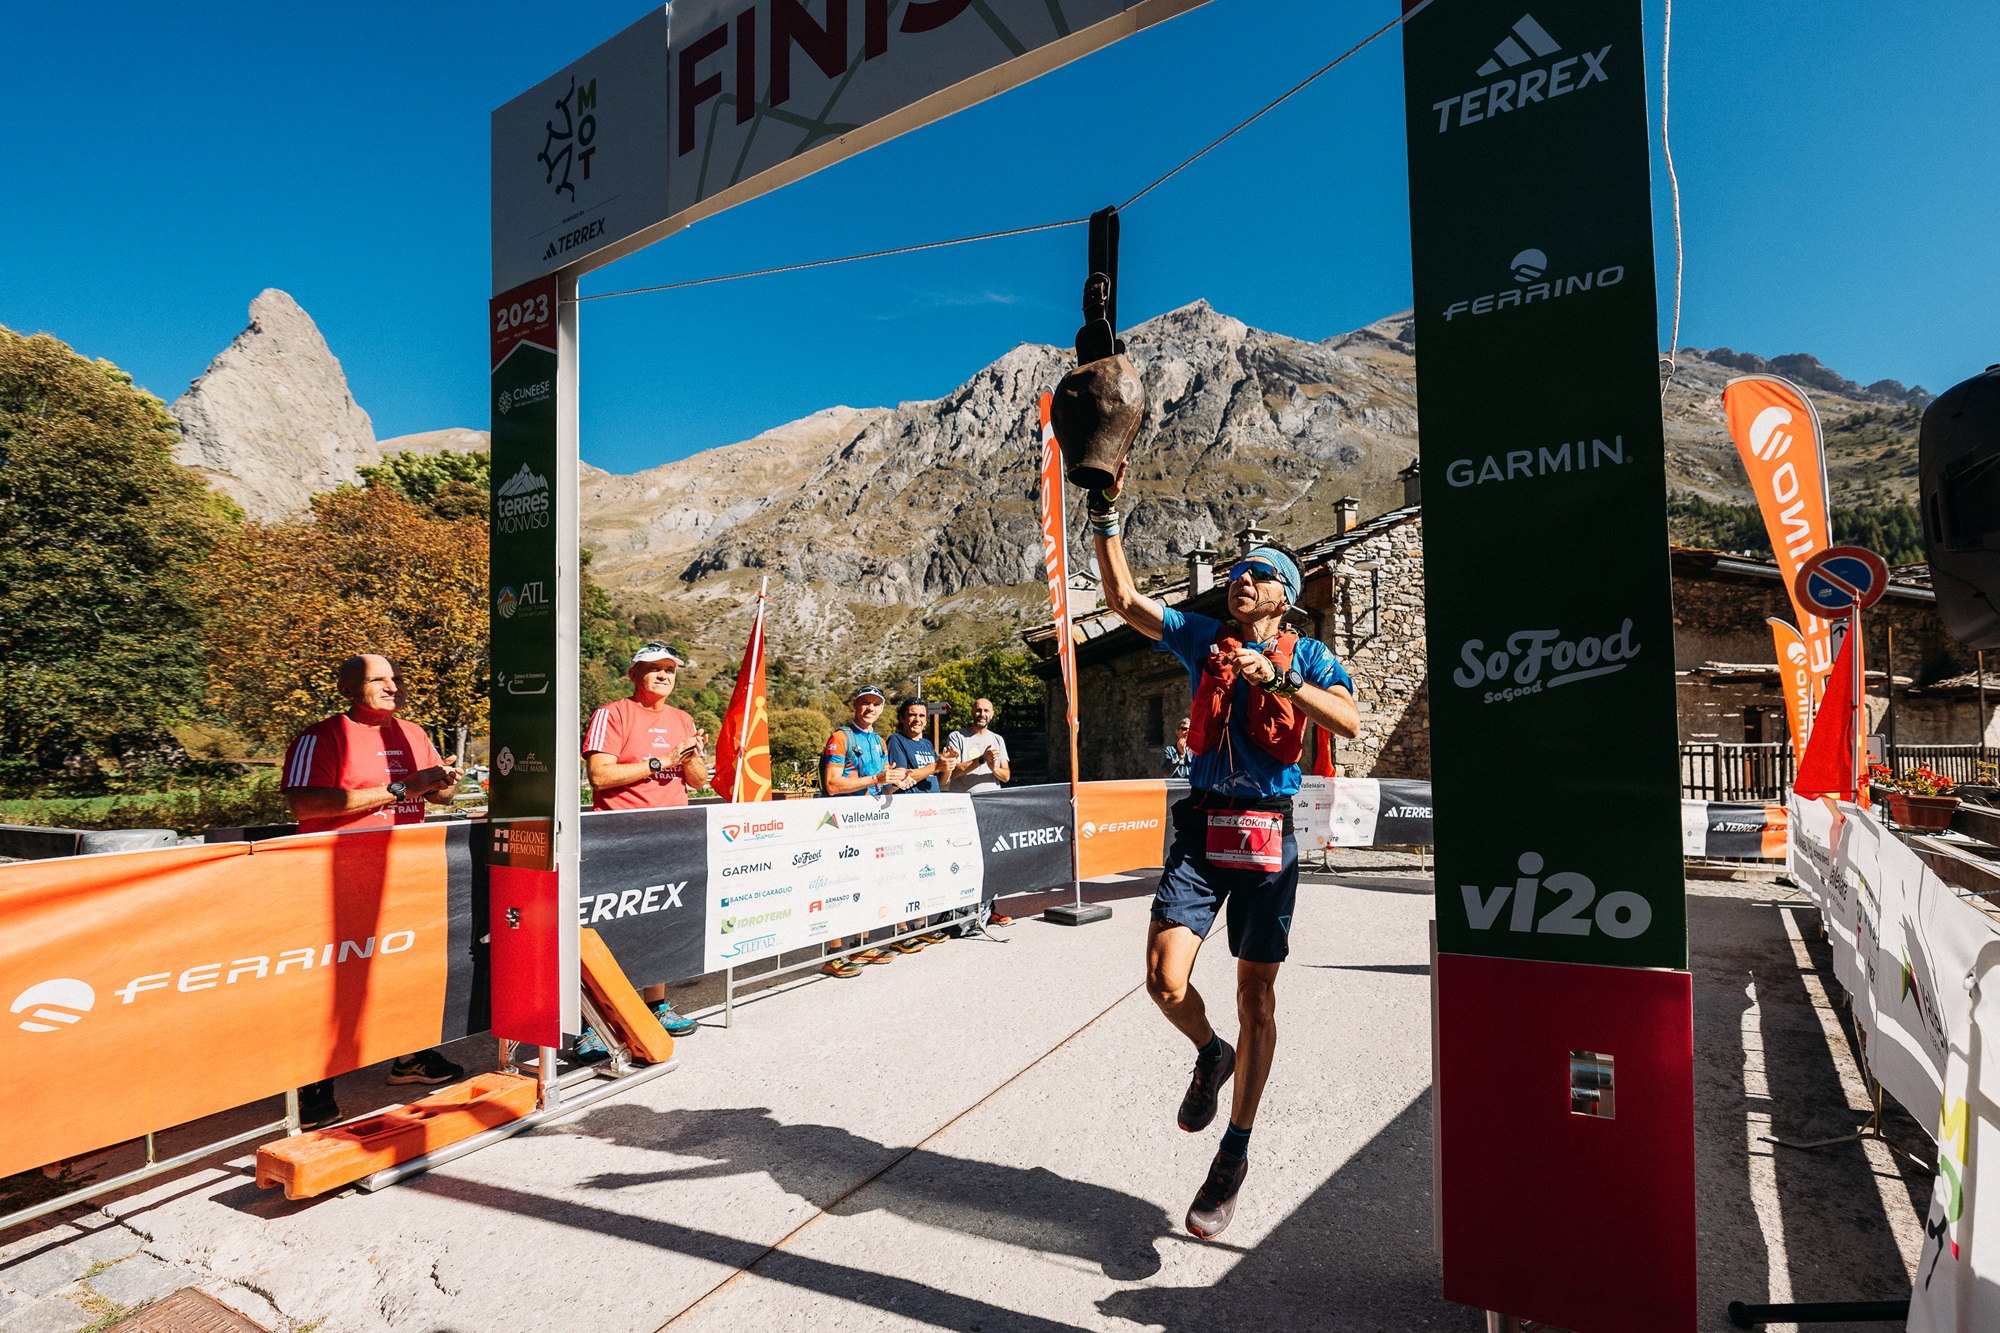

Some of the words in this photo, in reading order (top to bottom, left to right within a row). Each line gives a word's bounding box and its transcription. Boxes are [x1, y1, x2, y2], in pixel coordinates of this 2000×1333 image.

[1432, 44, 1612, 133] TERREX
[577, 78, 597, 181] MOT
[558, 217, 605, 254] TERREX
[1442, 265, 1624, 321] FERRINO
[496, 293, 549, 333] 2023
[513, 380, 550, 400] CUNEESE
[1446, 435, 1624, 488] GARMIN
[496, 510, 550, 535] MONVISO
[518, 581, 549, 605] ATL
[1453, 618, 1641, 689] SoFood
[1484, 680, 1542, 704] SoGood
[530, 765, 548, 773] MAIRA
[387, 804, 420, 814] TRAIL
[841, 809, 890, 823] ValleMaira
[743, 822, 750, 834] il
[752, 819, 784, 835] podio
[1098, 819, 1159, 833] FERRINO
[1226, 818, 1232, 826] 4
[1240, 818, 1267, 828] 40Km
[1725, 821, 1762, 833] TERREX
[510, 830, 546, 845] REGIONE
[922, 839, 935, 848] ATL
[1009, 826, 1065, 850] TERREX
[1238, 829, 1252, 850] 7
[509, 842, 545, 857] PIEMONTE
[792, 848, 822, 866] SoFood
[838, 845, 860, 859] vi2o
[722, 861, 772, 877] GARMIN
[580, 881, 689, 926] ERREX
[730, 893, 753, 904] BANCA
[754, 891, 761, 899] DI
[762, 886, 793, 898] CARAGLIO
[825, 894, 850, 904] ARMANDO
[1460, 851, 1652, 939] vi2o
[737, 908, 792, 929] IDROTERM
[113, 930, 415, 1005] FERRINO
